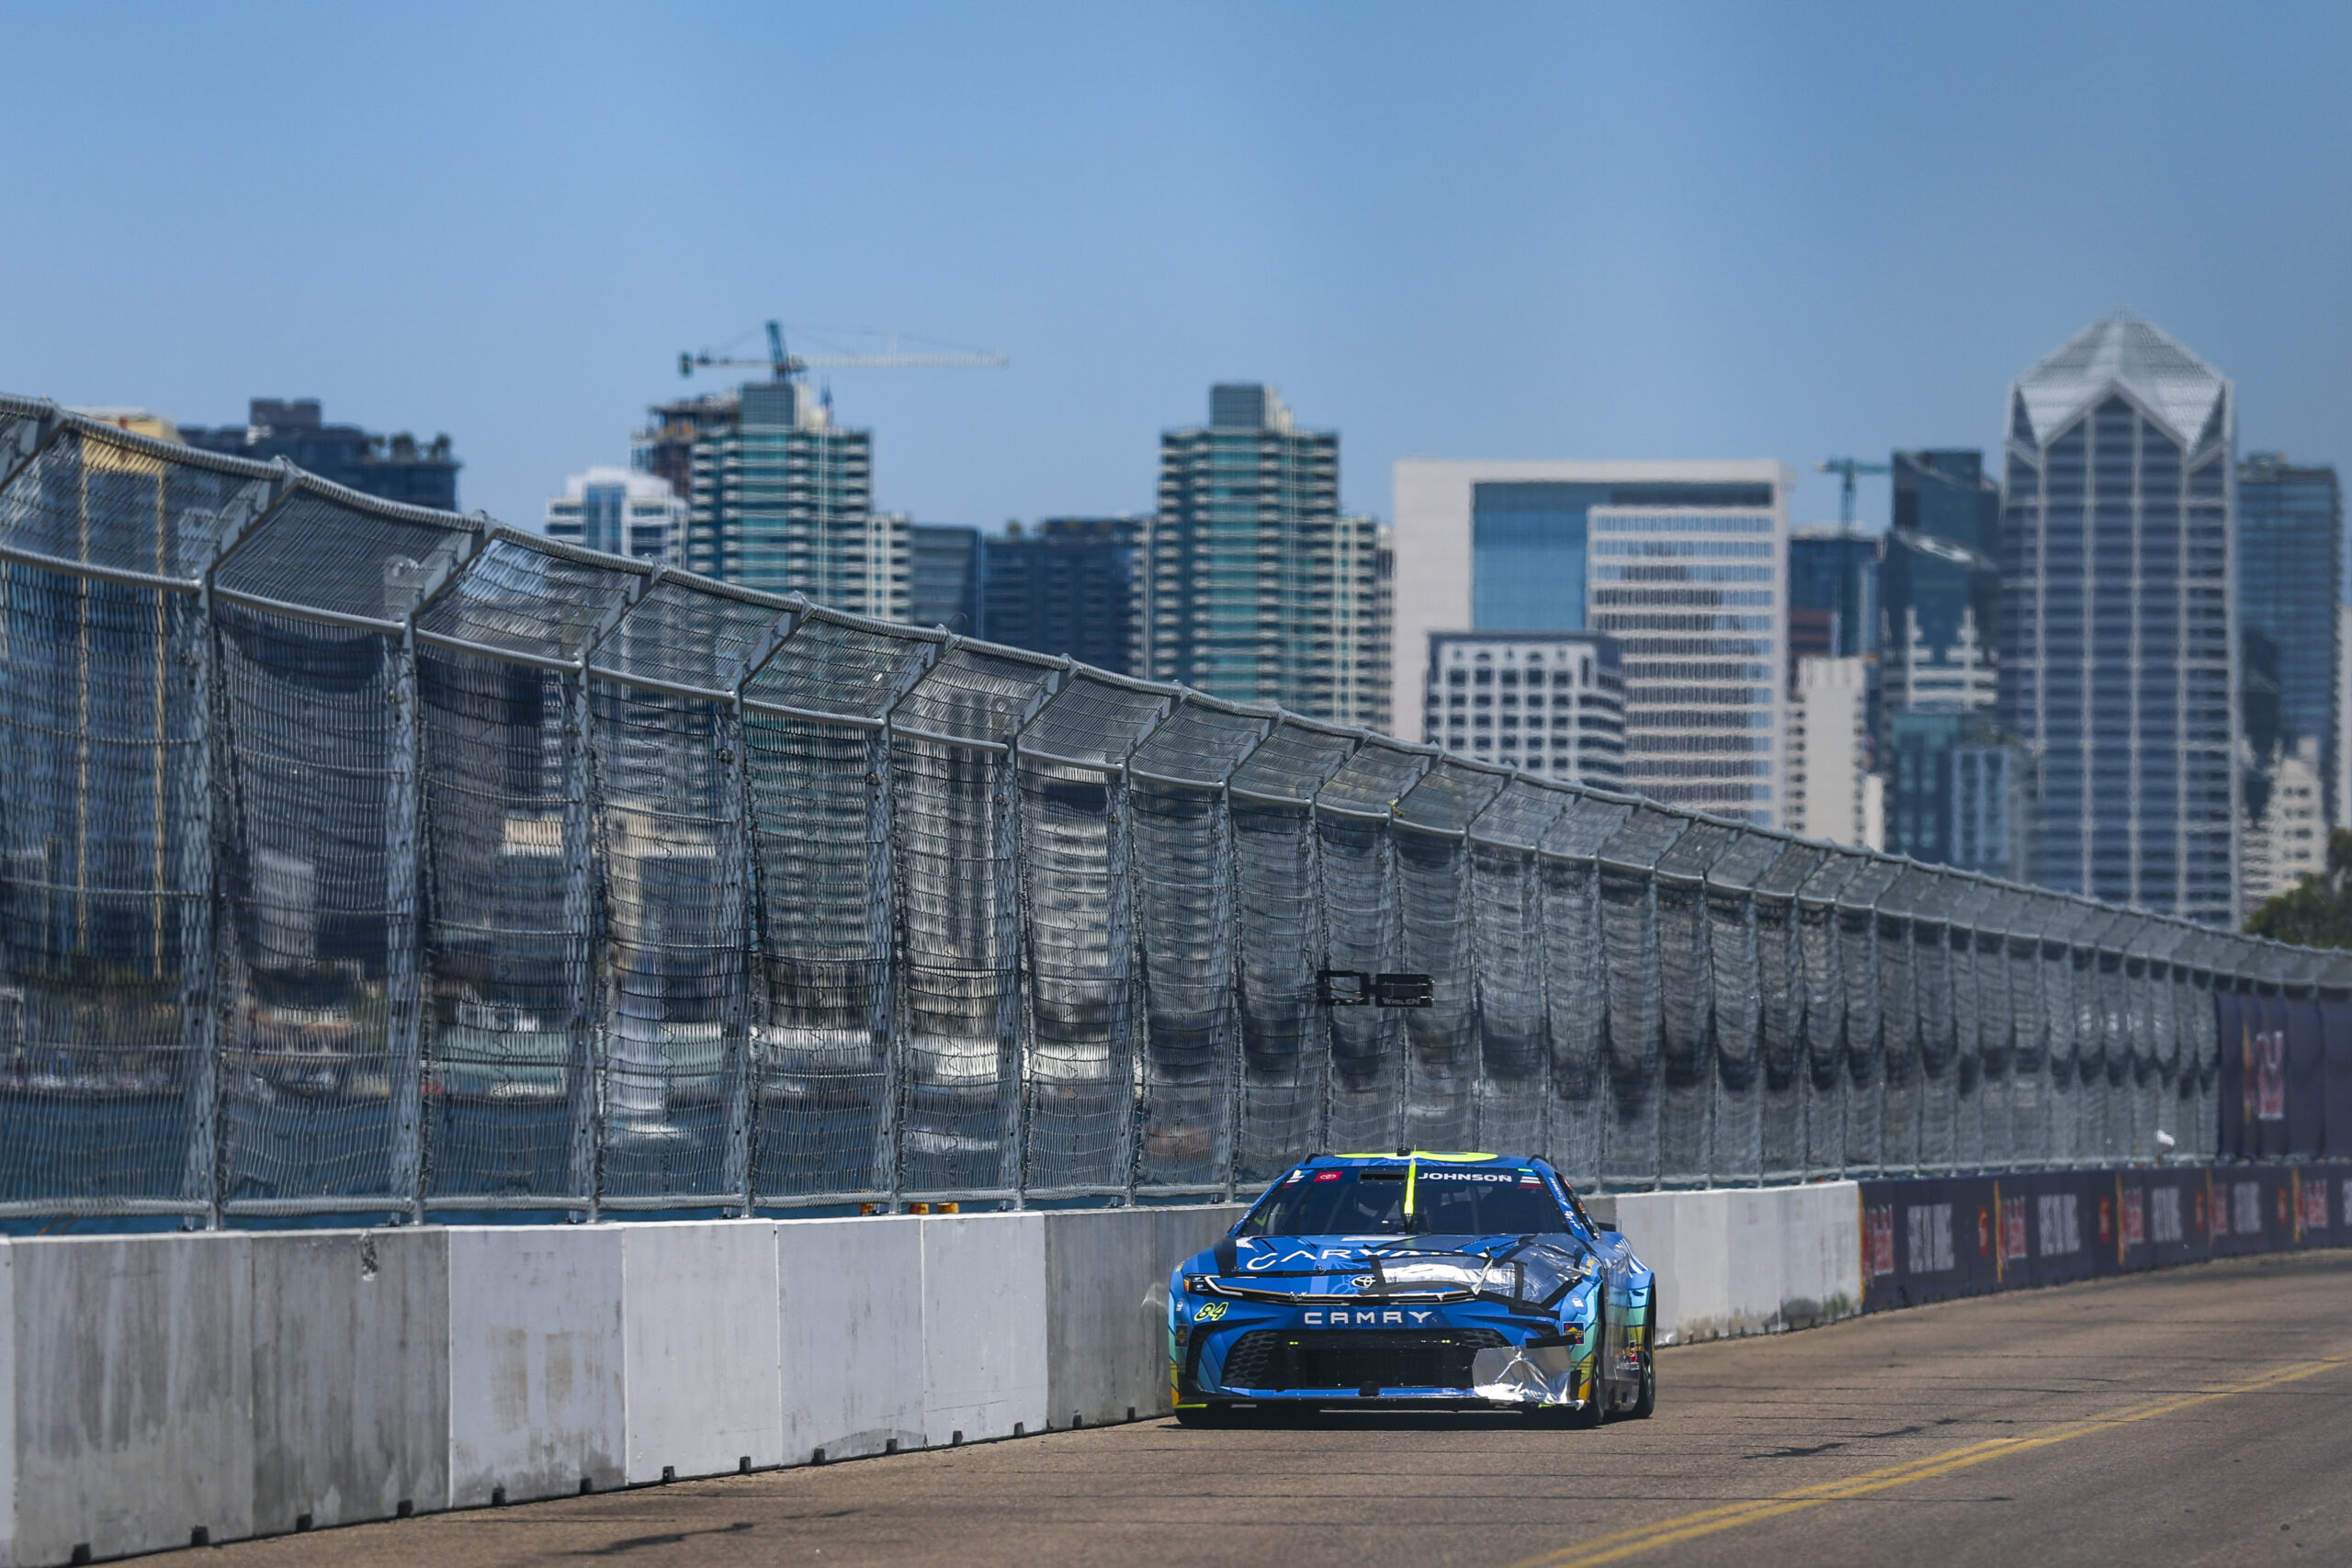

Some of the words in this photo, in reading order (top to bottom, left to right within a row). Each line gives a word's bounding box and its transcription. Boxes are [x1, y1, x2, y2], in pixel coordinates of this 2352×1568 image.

[1419, 1173, 1512, 1182] JOHNSON
[1194, 1302, 1229, 1321] 84
[1304, 1311, 1433, 1325] CAMRY
